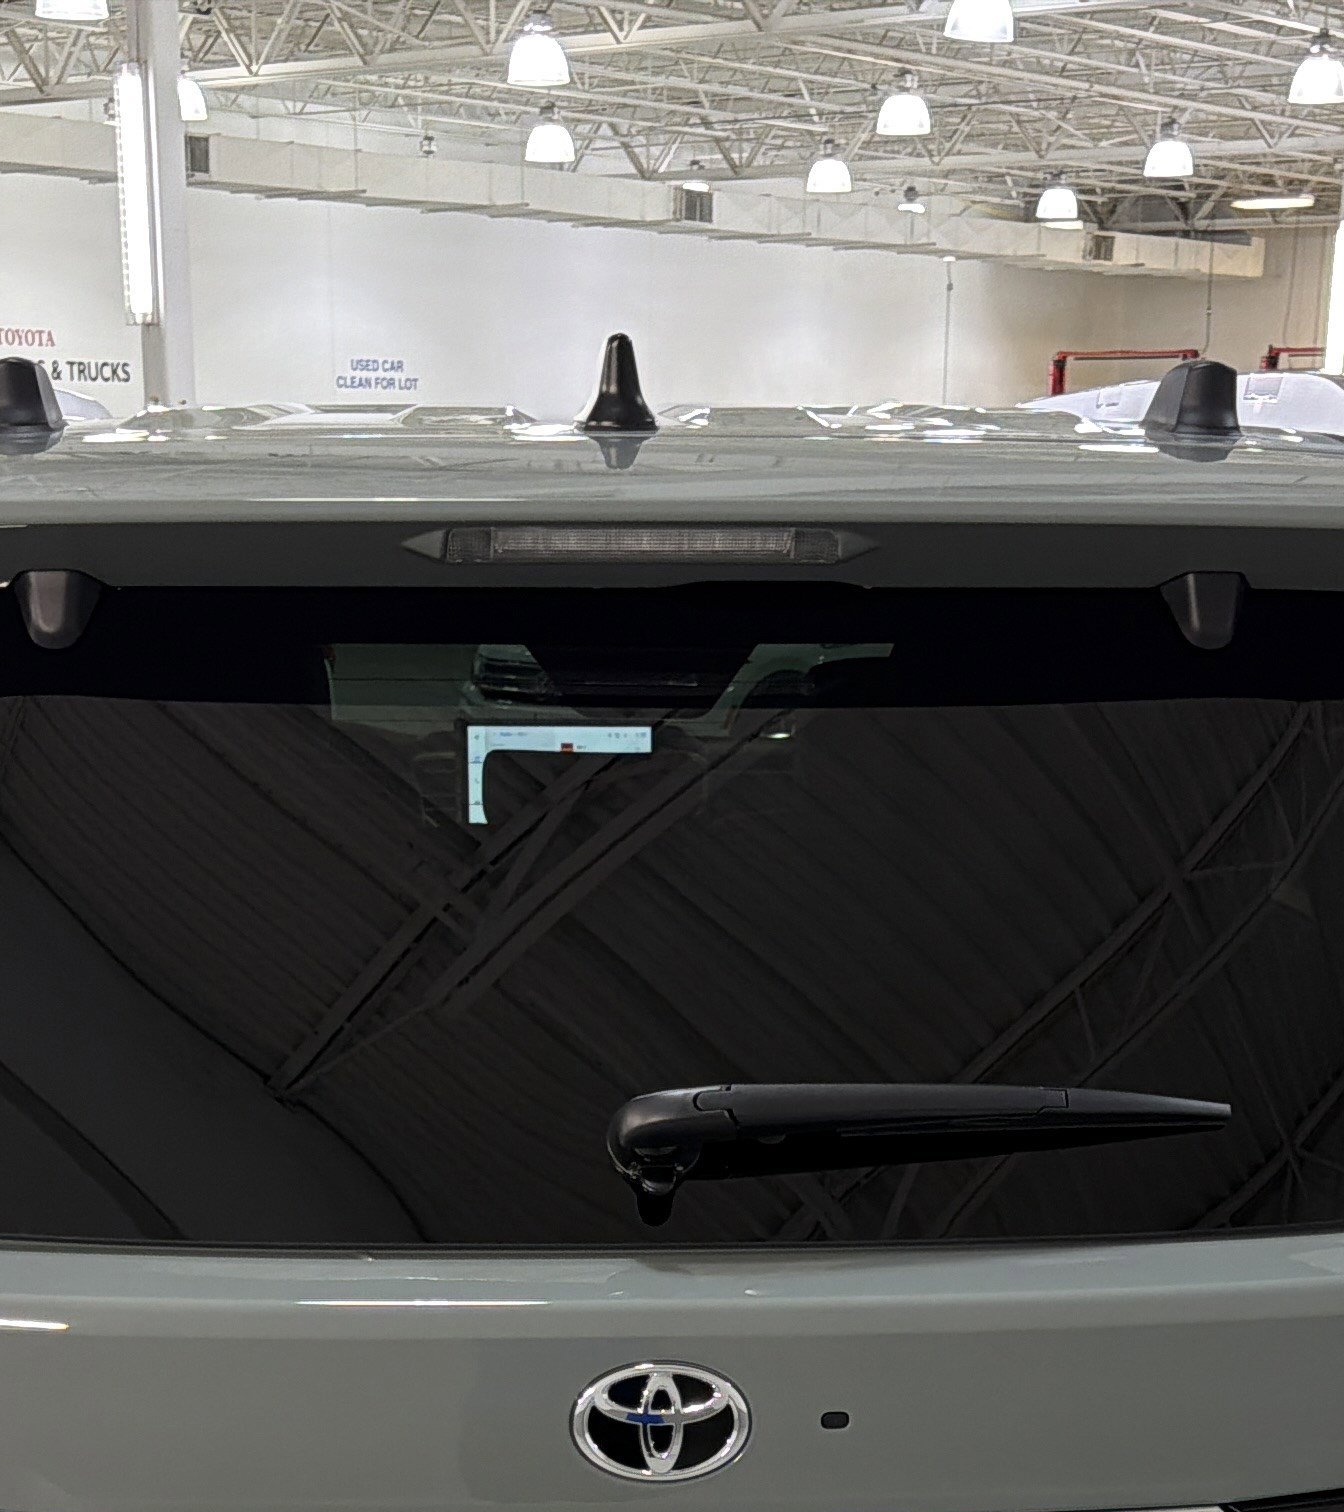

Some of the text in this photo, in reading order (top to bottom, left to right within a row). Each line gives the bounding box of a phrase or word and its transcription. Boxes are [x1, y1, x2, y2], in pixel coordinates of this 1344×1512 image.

[51, 359, 62, 381] &
[65, 360, 132, 383] TRUCKS
[350, 358, 404, 373] USED CAR
[335, 375, 419, 391] CLEAN FOR LOT
